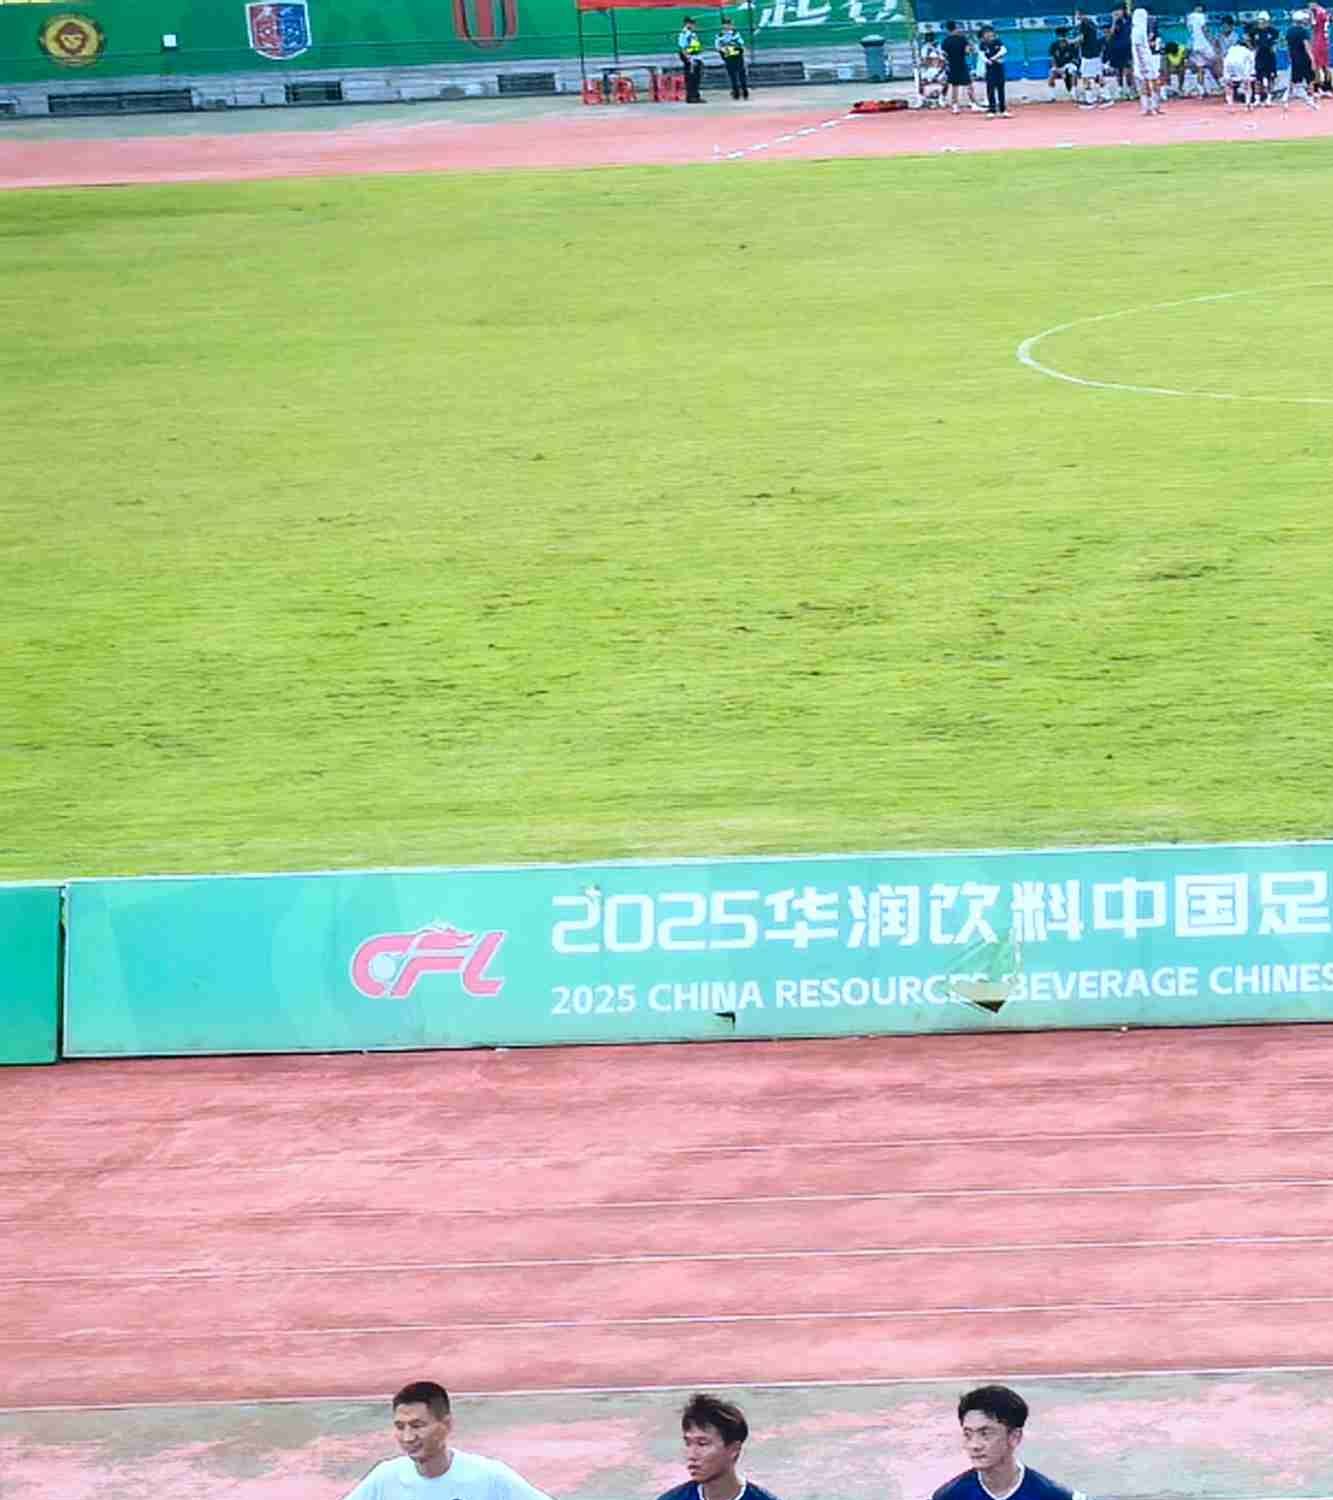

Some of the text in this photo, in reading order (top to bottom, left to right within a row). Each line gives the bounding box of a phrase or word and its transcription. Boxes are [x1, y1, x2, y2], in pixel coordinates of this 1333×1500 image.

[551, 984, 636, 1016] 2025
[648, 979, 764, 1013] CHINA
[1001, 966, 1199, 1002] BEVERAGE
